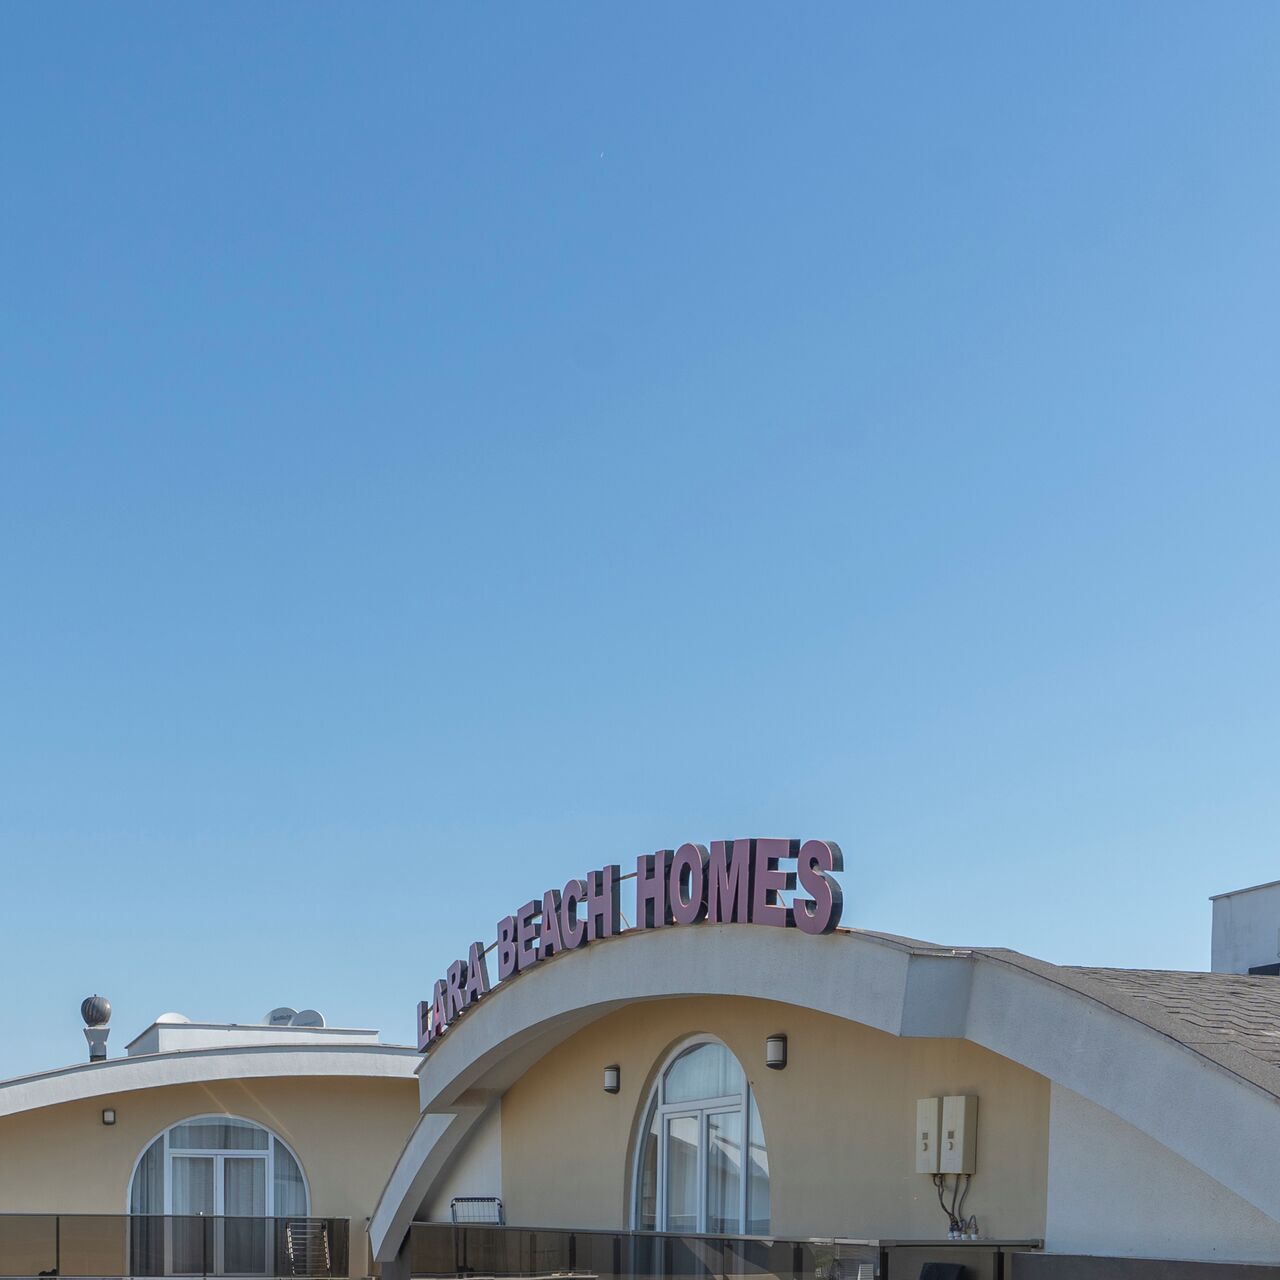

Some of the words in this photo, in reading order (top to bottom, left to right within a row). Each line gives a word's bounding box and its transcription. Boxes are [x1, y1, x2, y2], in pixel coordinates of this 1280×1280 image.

[417, 941, 491, 1054] LARA
[497, 865, 621, 981] BEACH
[636, 838, 844, 936] HOMES
